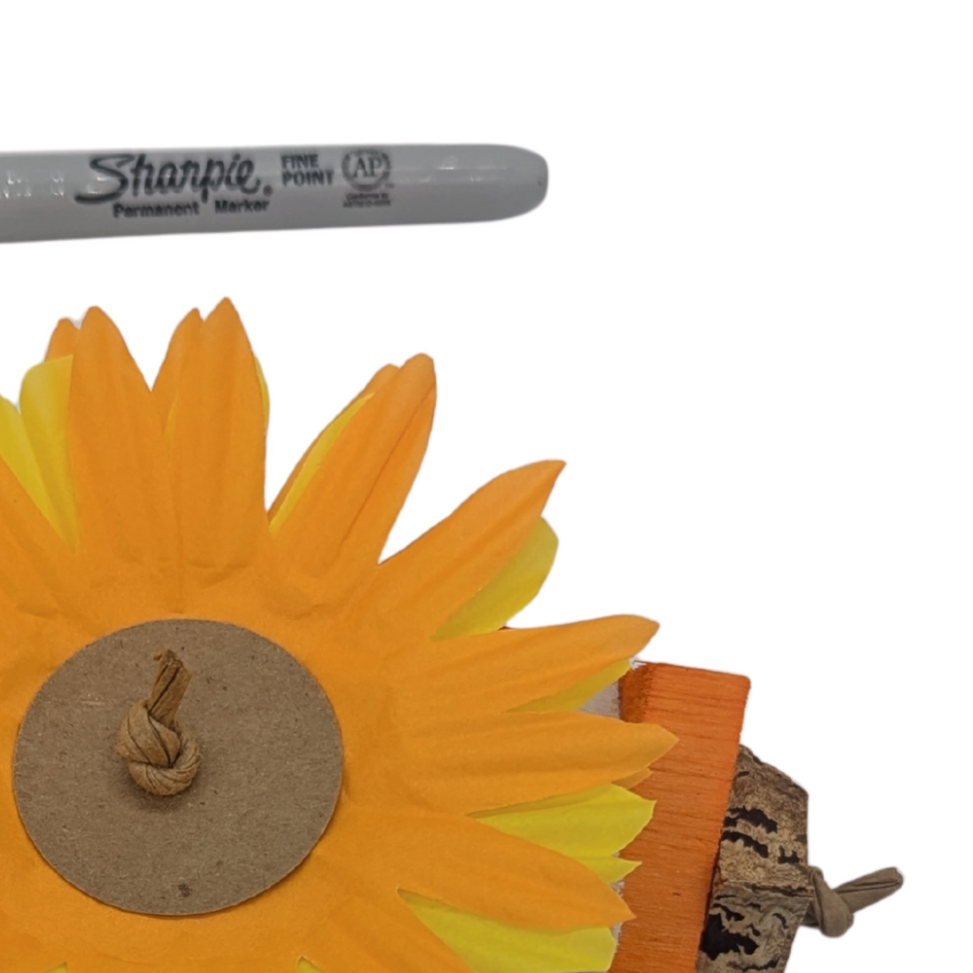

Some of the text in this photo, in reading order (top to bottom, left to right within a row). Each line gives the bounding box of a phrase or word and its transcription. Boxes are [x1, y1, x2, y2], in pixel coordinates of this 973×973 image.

[281, 154, 319, 169] FINE
[353, 157, 383, 178] AP
[282, 170, 334, 186] POINT
[113, 199, 269, 218] Permanent Marker
